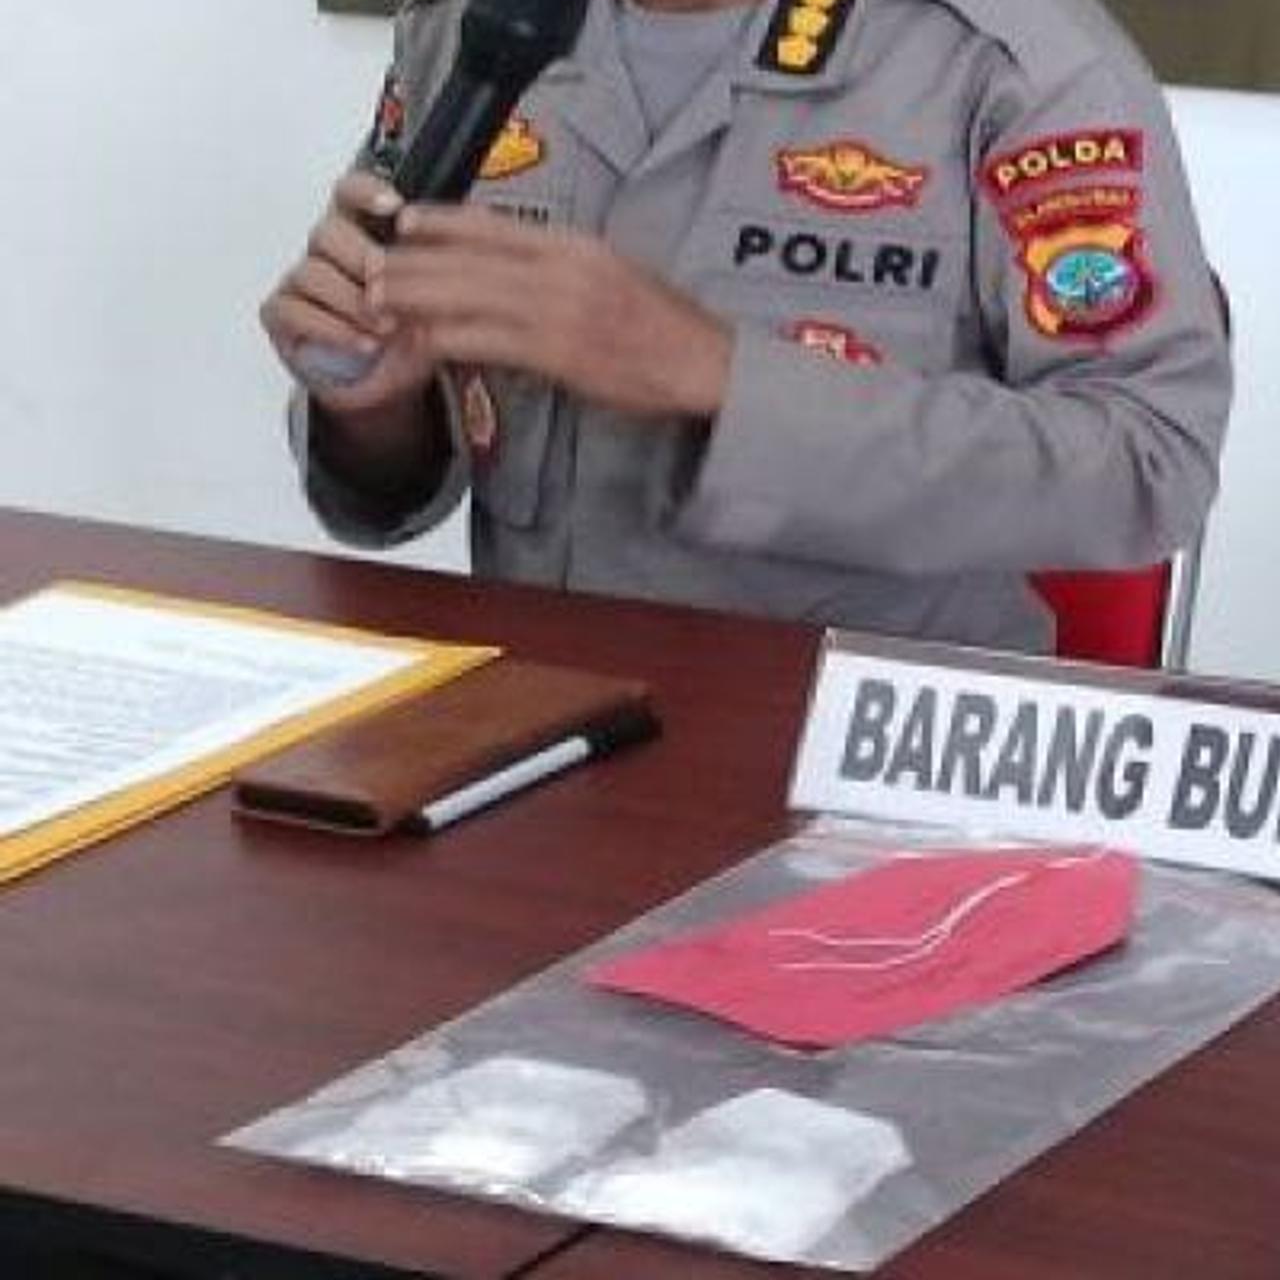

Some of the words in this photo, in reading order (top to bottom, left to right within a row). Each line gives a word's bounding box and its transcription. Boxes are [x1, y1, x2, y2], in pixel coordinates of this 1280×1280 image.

[998, 136, 1125, 192] POLDA
[732, 225, 941, 291] POLRI
[839, 677, 1155, 822] BARANG
